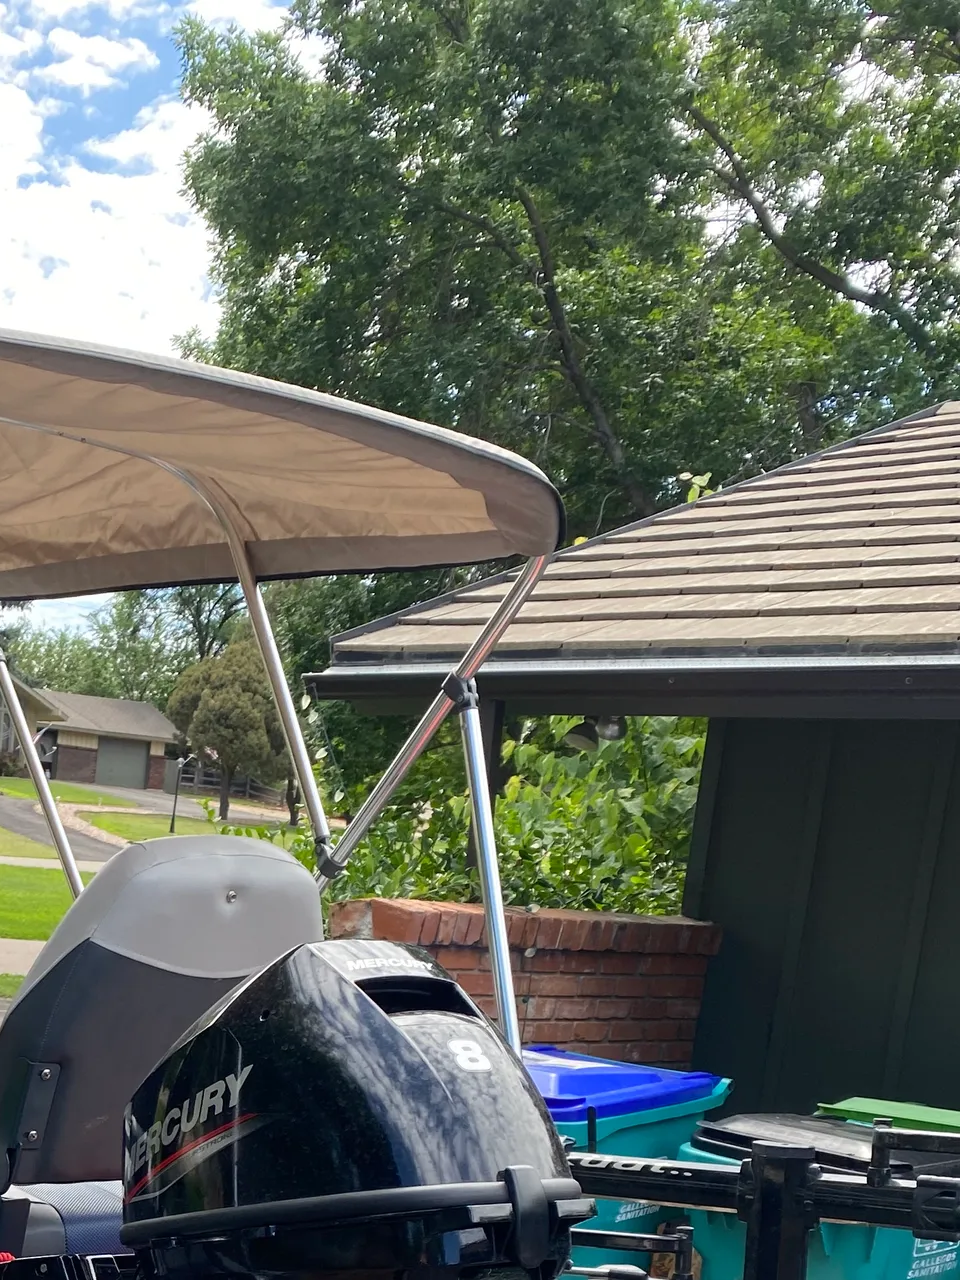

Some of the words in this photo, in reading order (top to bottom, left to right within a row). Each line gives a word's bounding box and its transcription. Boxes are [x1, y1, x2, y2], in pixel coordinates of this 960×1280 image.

[346, 958, 433, 971] MERCURY
[447, 1039, 493, 1073] 8
[615, 1205, 660, 1223] SANITATION
[907, 1261, 958, 1279] SANITATION
[912, 1252, 957, 1270] GALLEGOS
